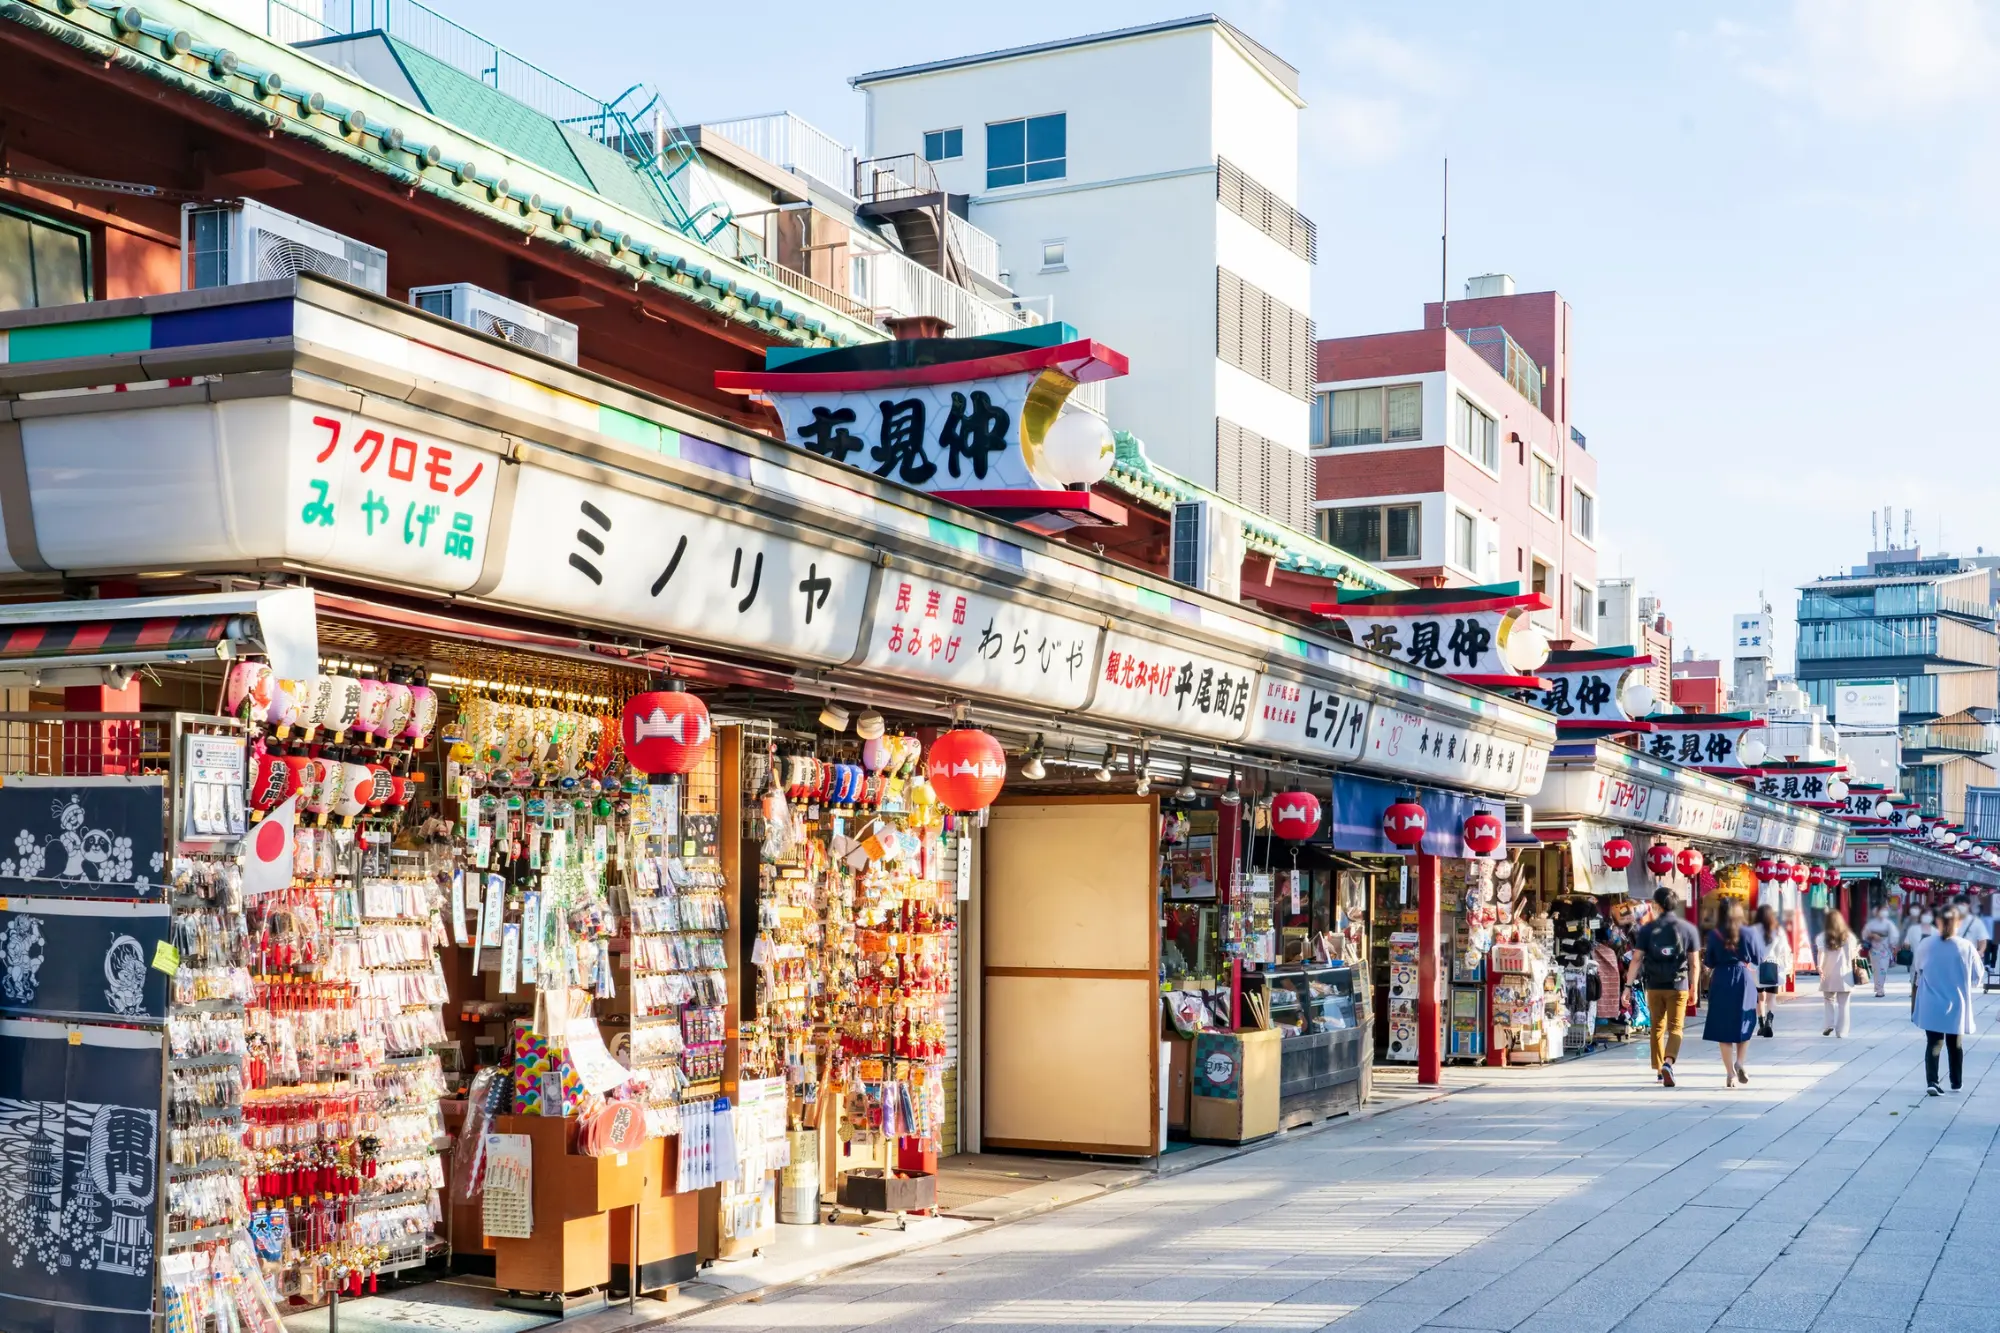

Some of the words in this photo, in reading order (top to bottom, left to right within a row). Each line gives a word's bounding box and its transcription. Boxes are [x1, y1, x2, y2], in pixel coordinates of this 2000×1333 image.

[312, 416, 484, 498] フクロモノ
[302, 479, 474, 561] みやげ品
[568, 500, 832, 625] ミノリヤ
[895, 583, 967, 625] 民芸品
[887, 624, 961, 664] おみやげ
[977, 617, 1083, 681] わらびや
[1738, 636, 1762, 647] 三定
[1105, 650, 1176, 697] 観光みやげ
[1174, 660, 1249, 722] 平尾商店
[1305, 689, 1363, 749] ヒラノヤ
[105, 1108, 152, 1197] 雷門
[610, 1108, 632, 1144] 浅草
